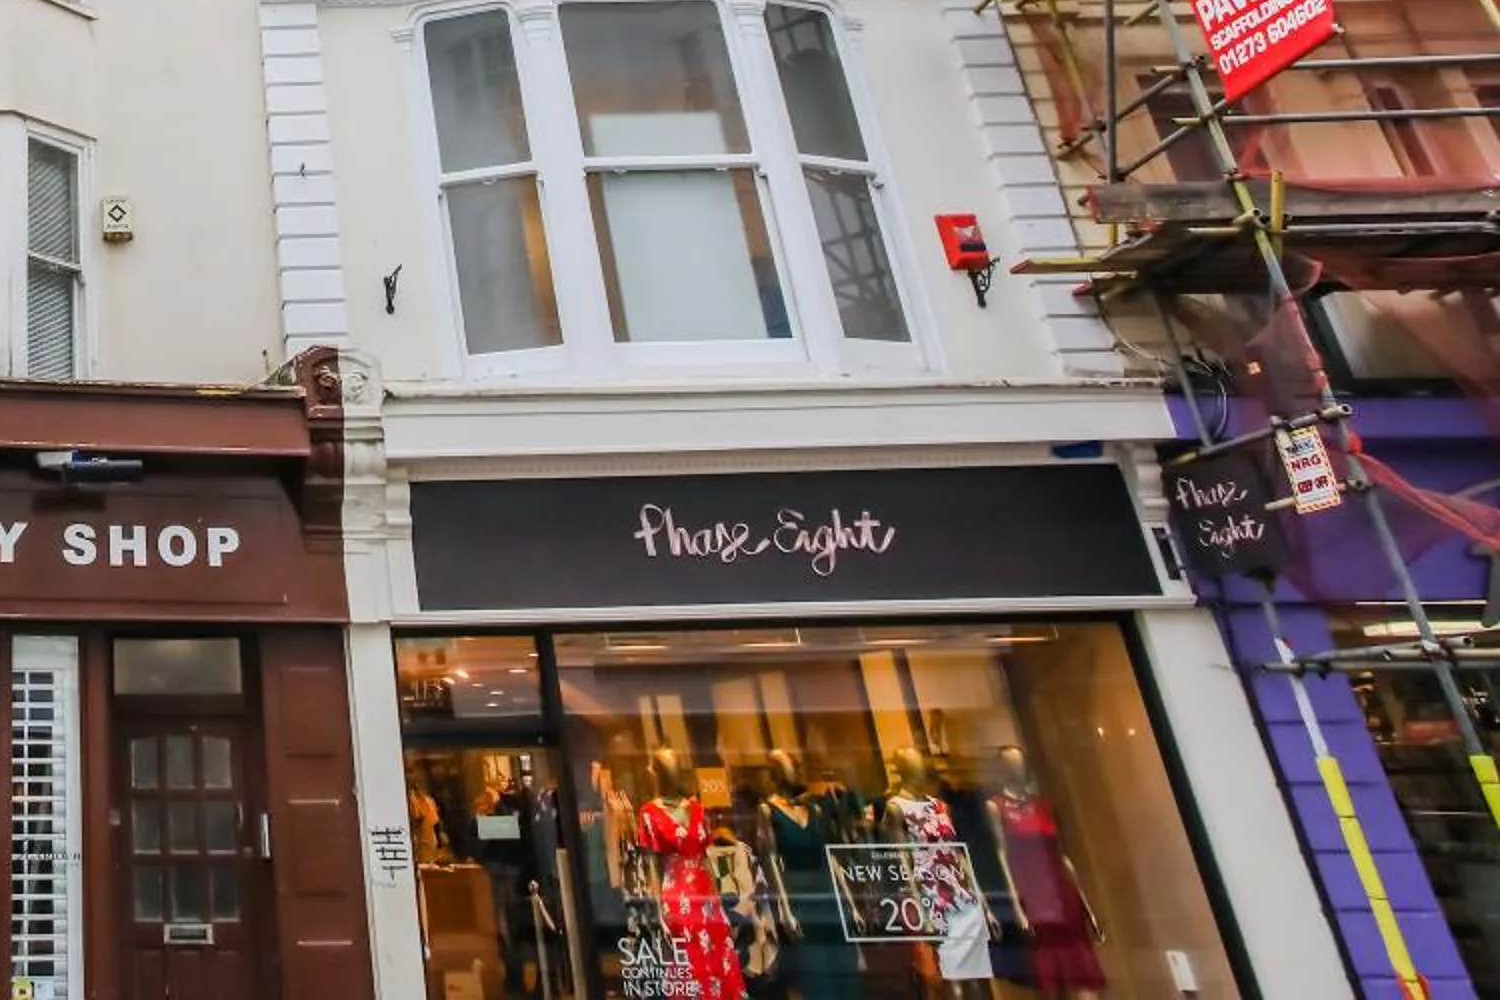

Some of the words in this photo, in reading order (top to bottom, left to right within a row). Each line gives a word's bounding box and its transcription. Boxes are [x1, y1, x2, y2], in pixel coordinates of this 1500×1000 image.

[1219, 31, 1267, 75] 01273
[1175, 477, 1248, 508] Phase
[61, 523, 240, 567] SHOP
[633, 503, 771, 563] Phase
[773, 507, 896, 577] Eight
[1198, 513, 1265, 559] Eight
[844, 865, 882, 882] NEW
[617, 936, 690, 966] SALE
[621, 966, 693, 979] CONTINUES
[623, 980, 641, 998] IN
[643, 980, 697, 998] STORE
